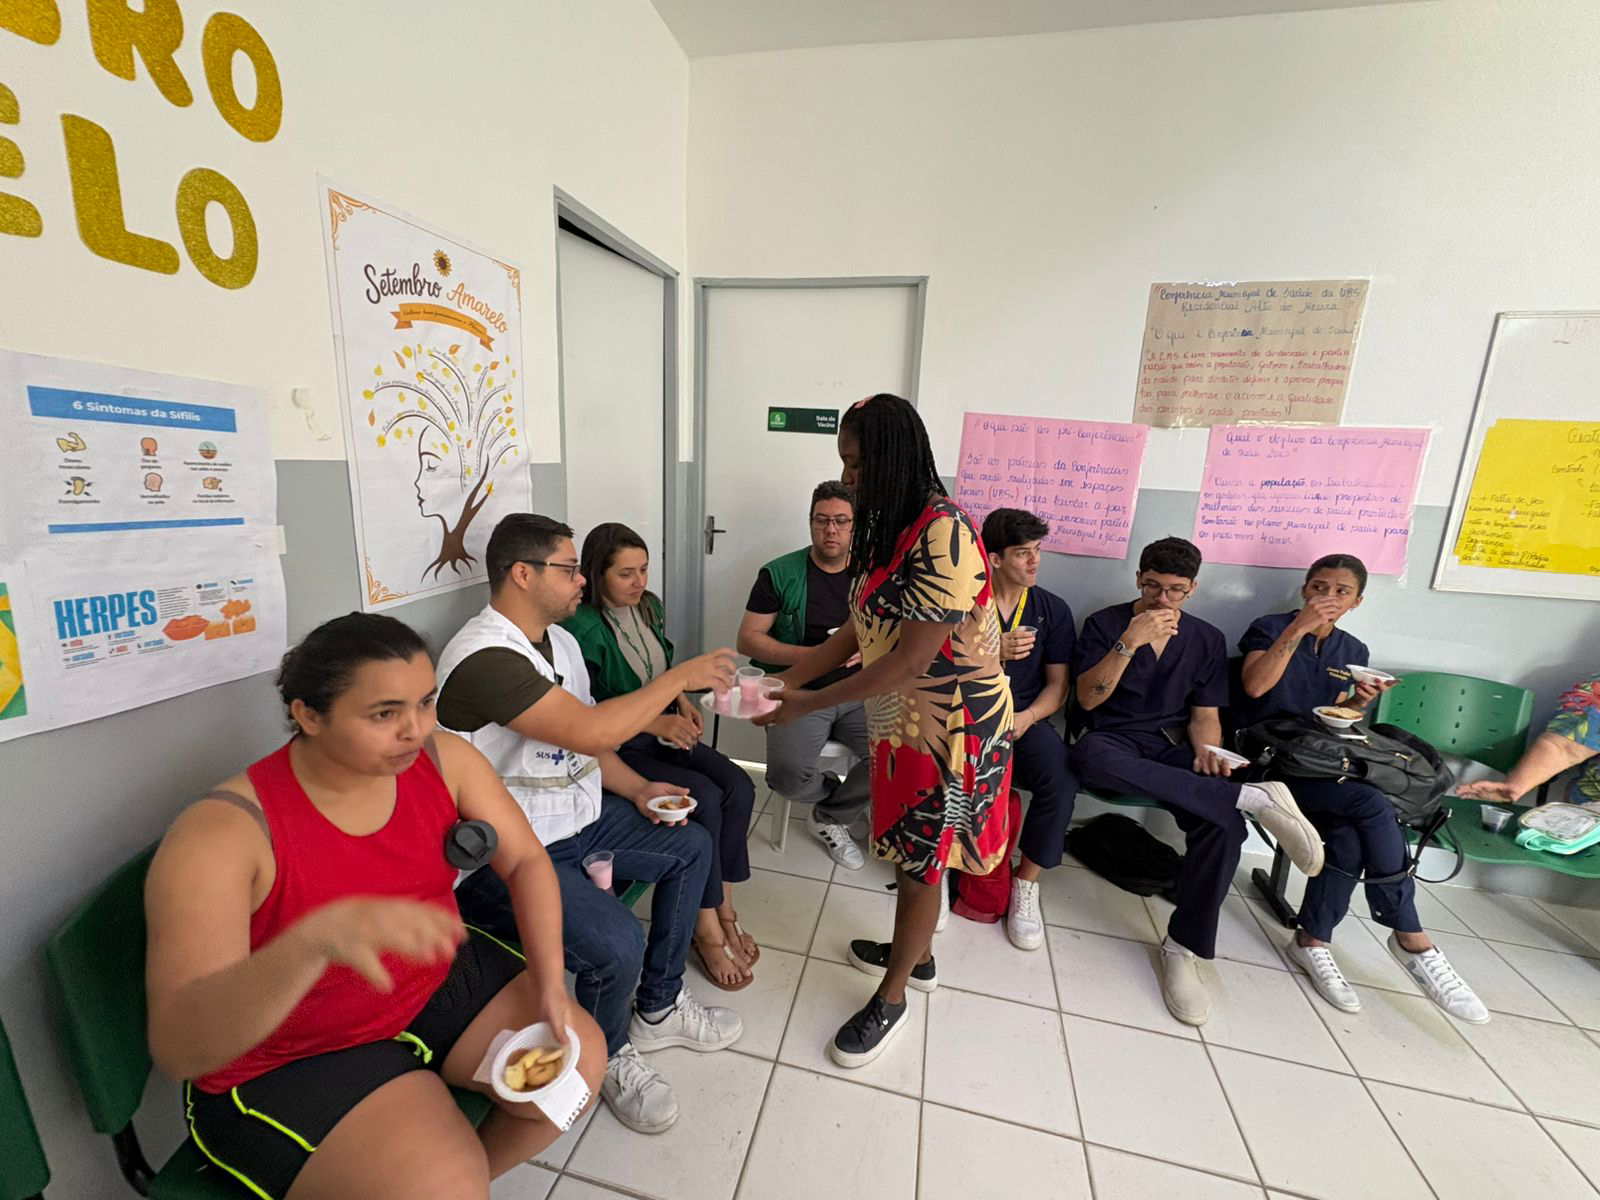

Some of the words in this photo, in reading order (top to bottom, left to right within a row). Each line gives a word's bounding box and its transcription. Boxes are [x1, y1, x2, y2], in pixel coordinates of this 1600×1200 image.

[364, 262, 442, 304] Setembro
[1266, 287, 1278, 298] de
[1321, 288, 1334, 298] da
[447, 281, 508, 333] Amarelo
[72, 400, 84, 410] 6
[86, 402, 148, 417] Sintomas
[150, 408, 167, 418] da
[1037, 426, 1050, 435] as
[988, 457, 1001, 467] as
[53, 589, 159, 640] HERPES
[536, 751, 551, 760] SUS
